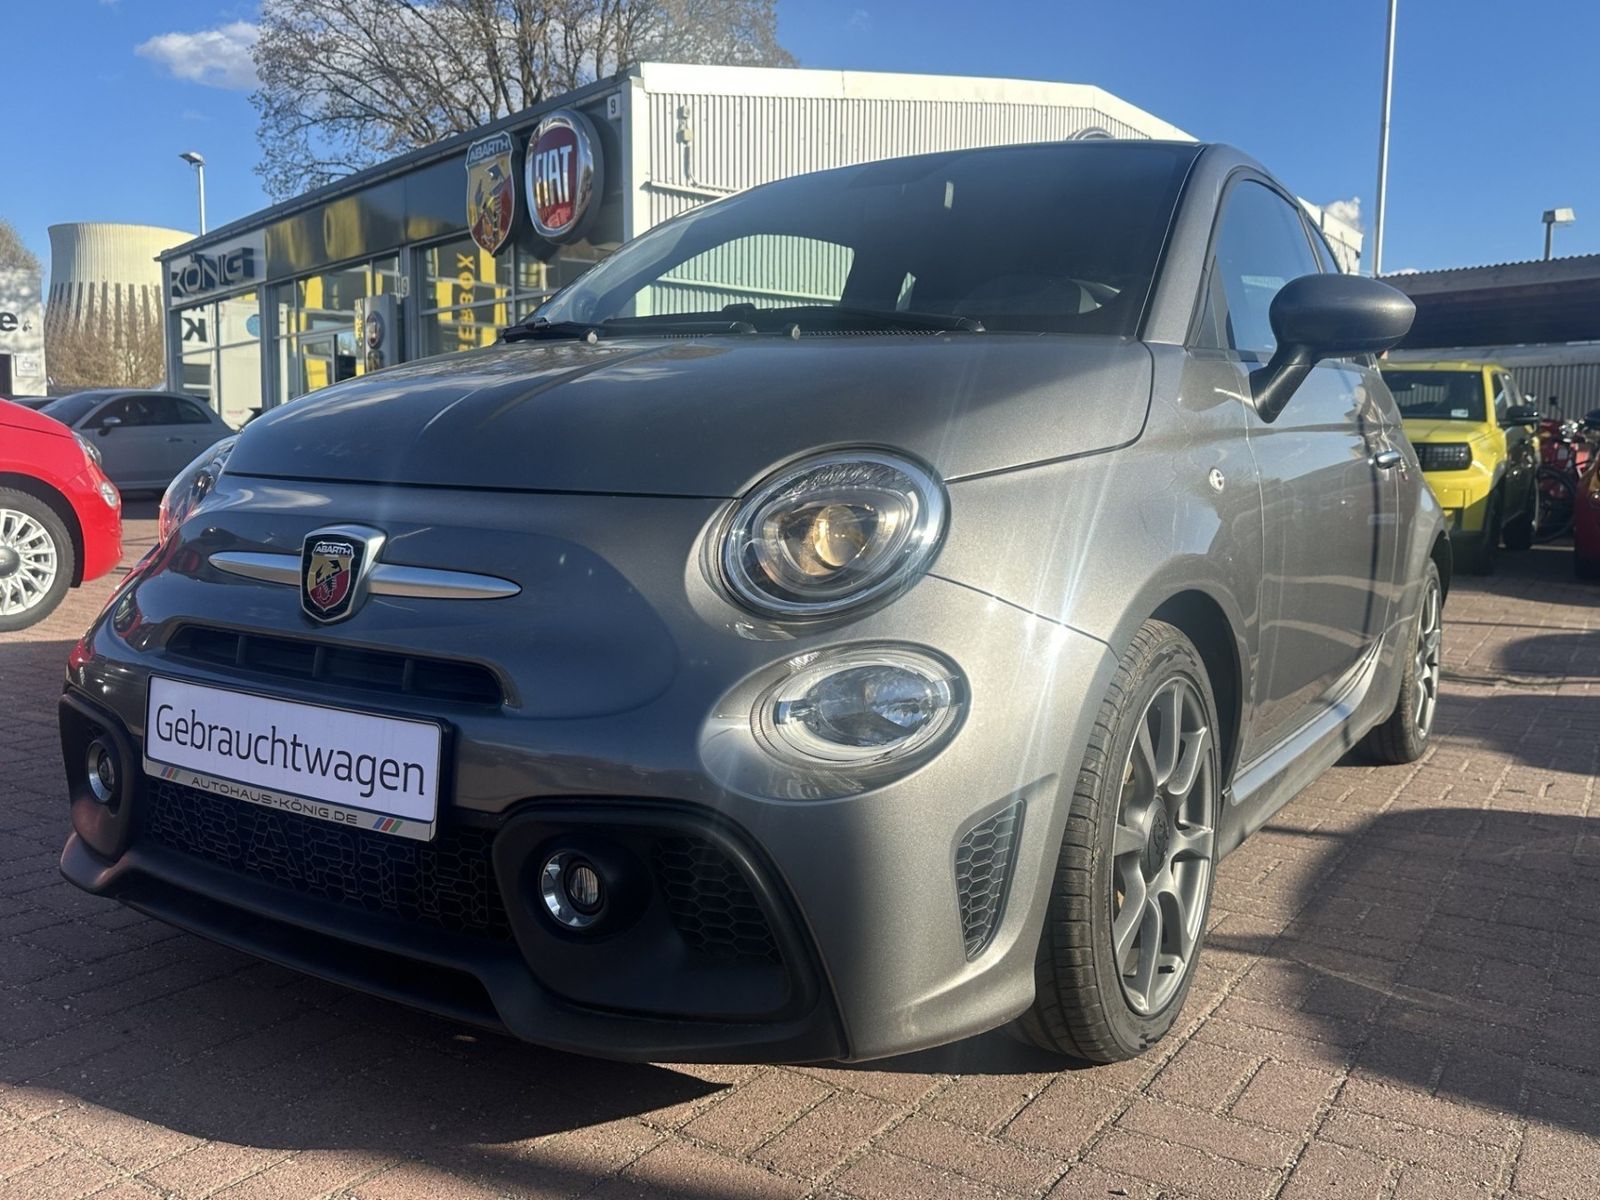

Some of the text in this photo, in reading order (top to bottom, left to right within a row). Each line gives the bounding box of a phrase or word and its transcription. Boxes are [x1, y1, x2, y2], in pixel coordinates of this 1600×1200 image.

[610, 98, 617, 115] 9
[469, 139, 510, 163] ABARTH
[534, 144, 573, 209] FIAT
[171, 247, 255, 297] KÖNIG
[315, 545, 351, 555] ABARTH
[156, 704, 425, 798] Gebrauchtwagen
[191, 776, 358, 825] AUTOHAUS-KÖNIG.DE
